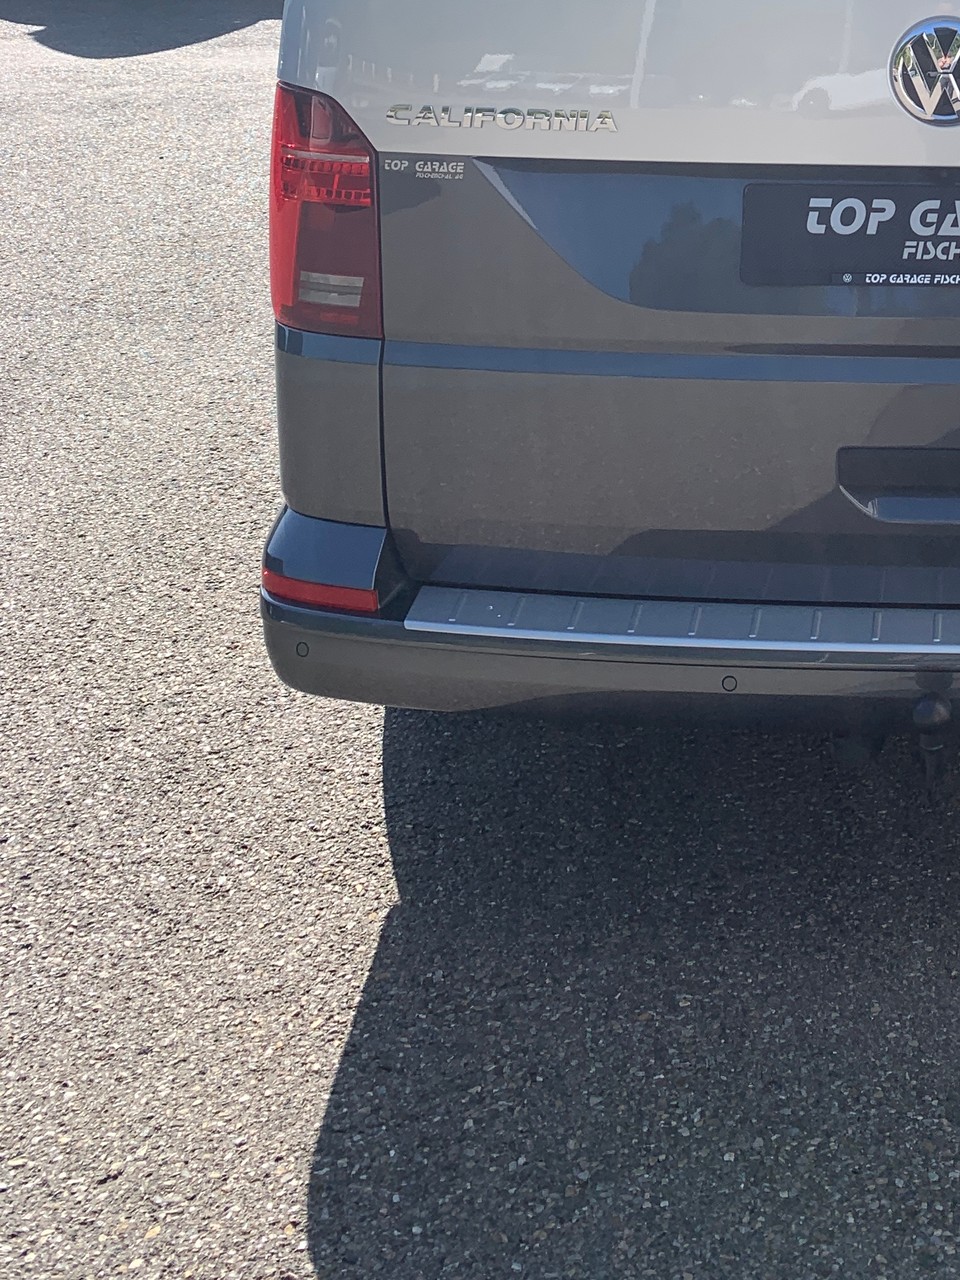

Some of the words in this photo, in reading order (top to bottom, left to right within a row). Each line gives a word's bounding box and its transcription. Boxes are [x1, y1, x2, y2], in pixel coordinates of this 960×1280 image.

[385, 103, 619, 133] CALIFORNIA
[384, 159, 409, 171] TOP
[415, 161, 465, 173] GARAGE
[805, 197, 897, 235] TOP
[865, 273, 886, 284] TOP
[889, 274, 931, 284] GARAGE
